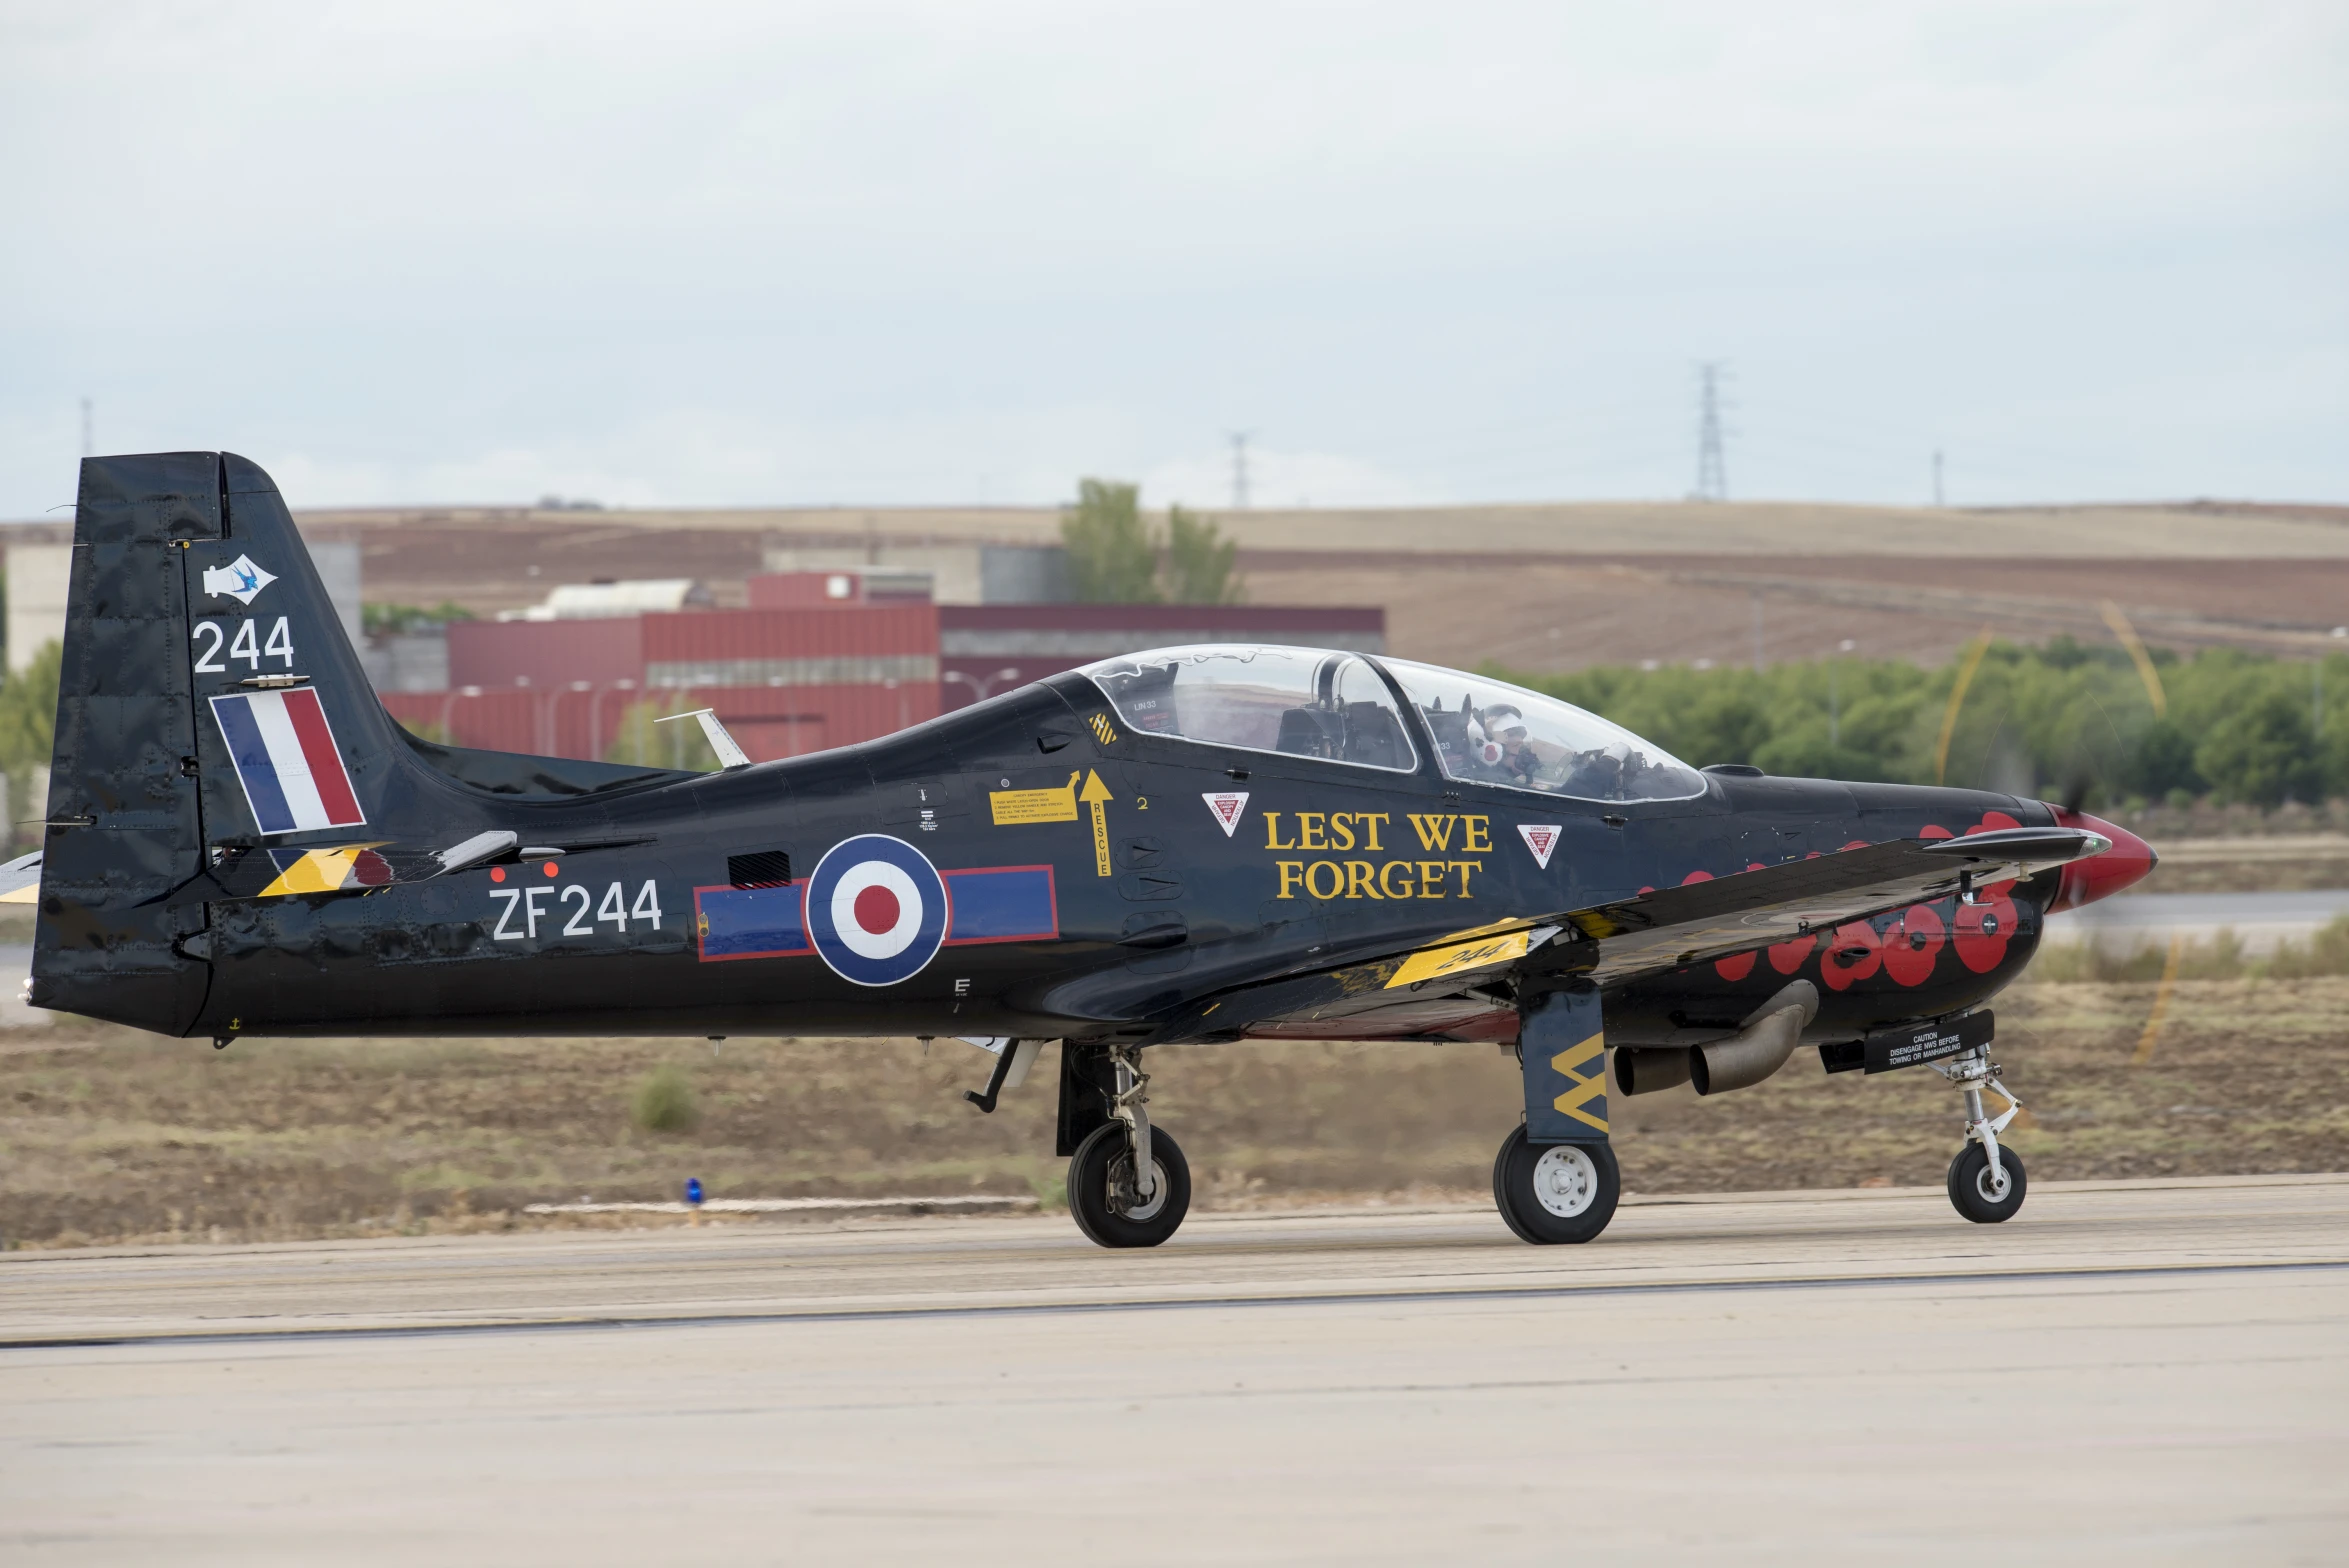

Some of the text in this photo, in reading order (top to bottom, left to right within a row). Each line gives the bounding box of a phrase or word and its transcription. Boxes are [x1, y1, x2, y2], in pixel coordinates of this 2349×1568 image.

[192, 616, 294, 674] 244
[1146, 700, 1157, 709] 33
[1137, 796, 1148, 810] 2
[1094, 803, 1108, 874] RESCUE
[1262, 812, 1494, 853] LEST WE
[1276, 860, 1483, 900] FORGET
[489, 879, 662, 941] ZF244
[1438, 940, 1510, 970] 244
[954, 978, 971, 992] E
[1890, 1034, 1960, 1057] DISENGAGE NWS BEFORE
[1914, 1032, 1938, 1044] CAUTION
[1889, 1055, 1911, 1065] TOWING
[1923, 1043, 1961, 1058] MANHANDLING
